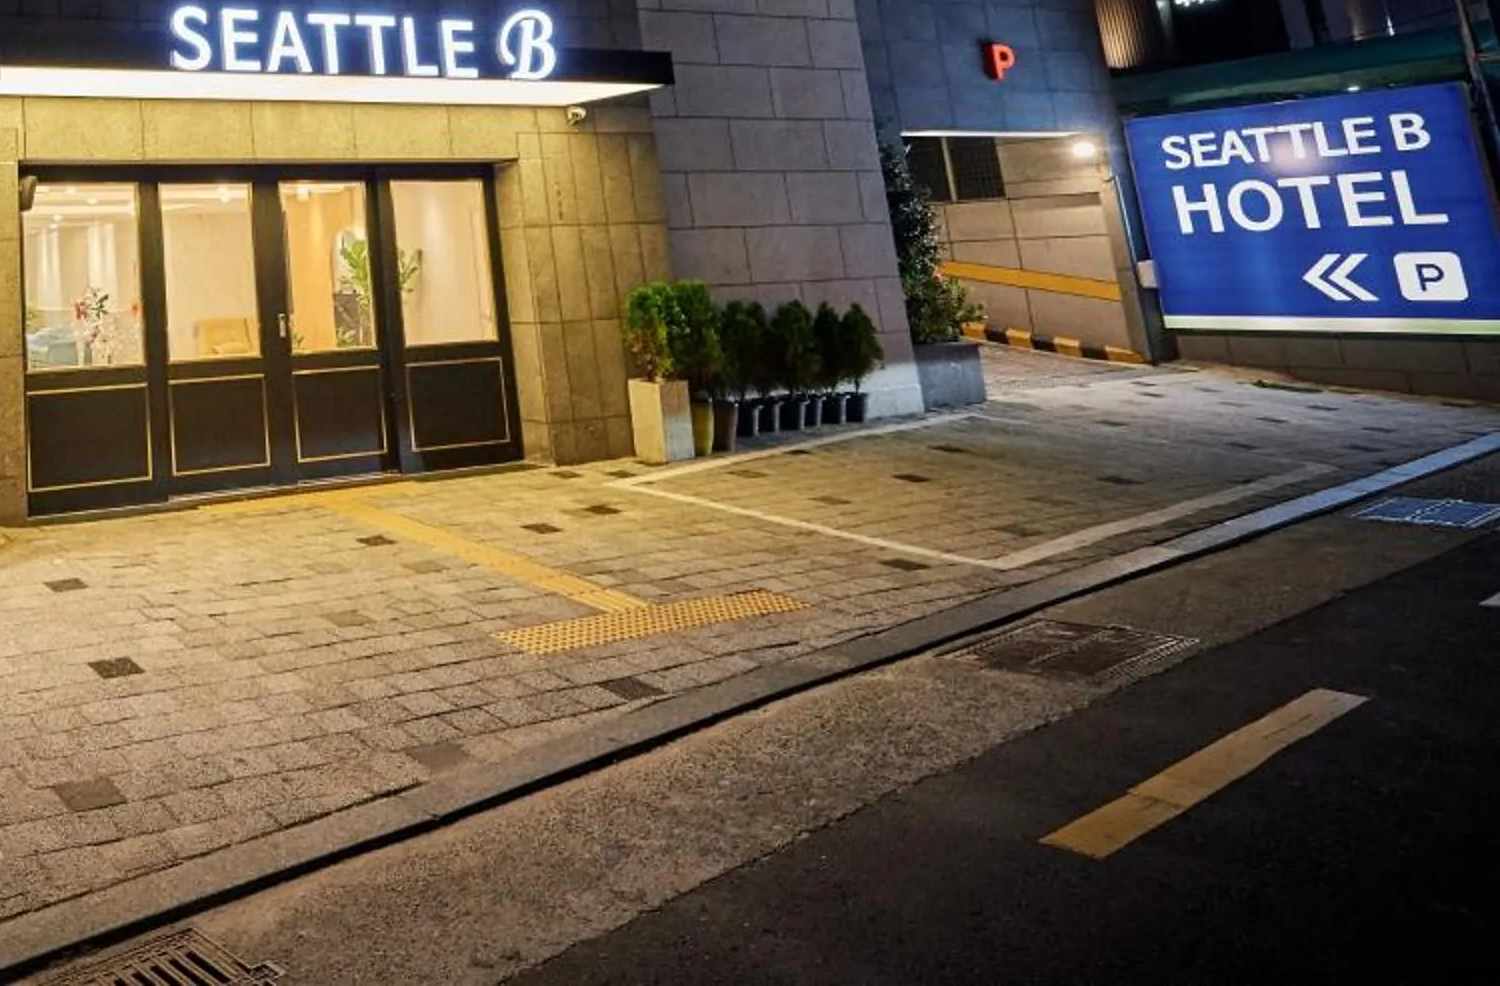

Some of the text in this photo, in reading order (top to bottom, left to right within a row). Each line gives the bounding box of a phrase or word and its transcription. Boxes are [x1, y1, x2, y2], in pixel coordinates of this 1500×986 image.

[169, 4, 558, 81] SEATTLE B
[990, 42, 1016, 81] P
[1160, 112, 1432, 171] SEATTLE B
[1170, 169, 1450, 235] HOTEL
[1415, 263, 1445, 292] P
